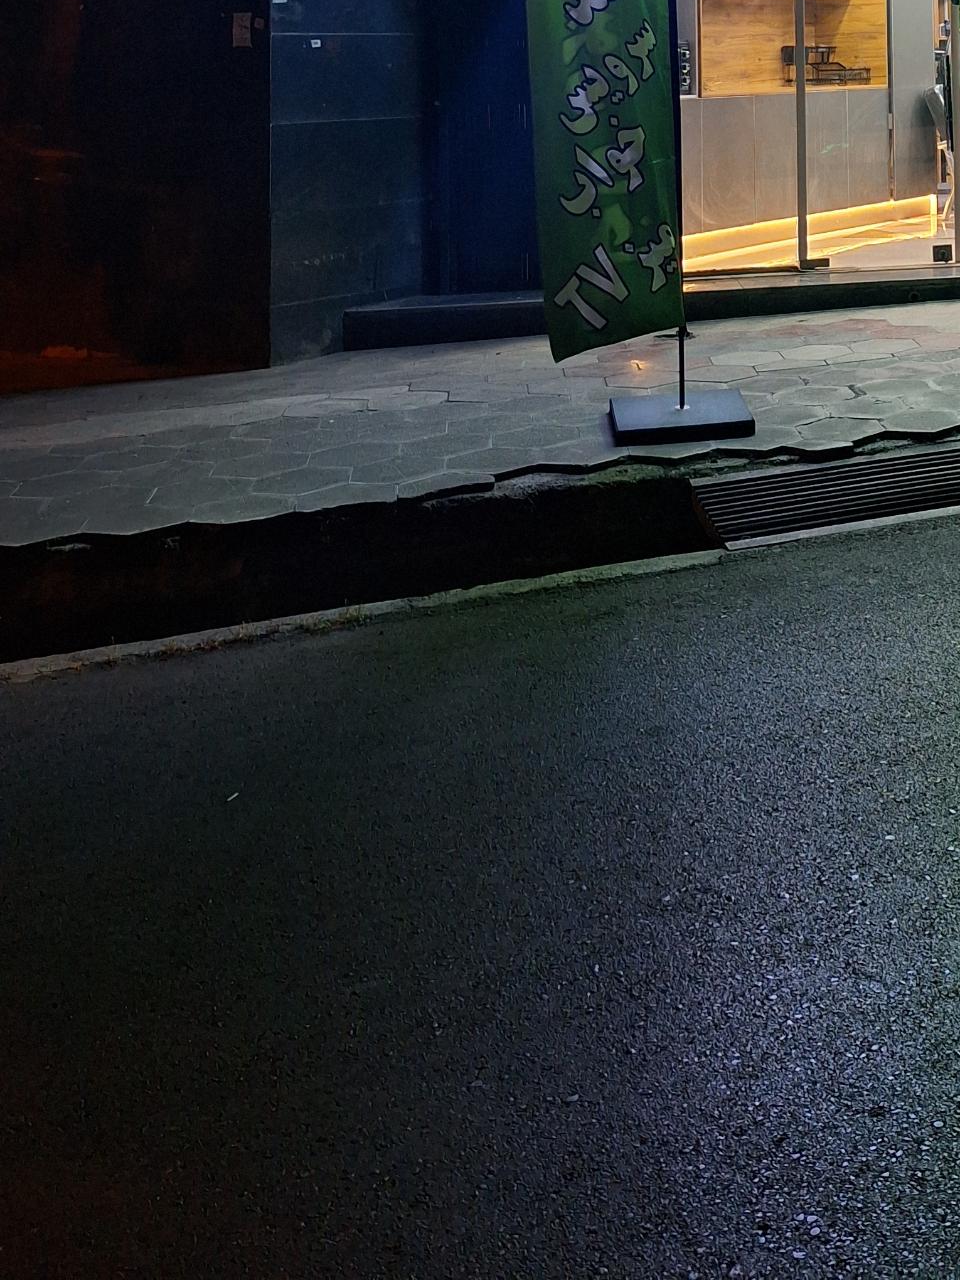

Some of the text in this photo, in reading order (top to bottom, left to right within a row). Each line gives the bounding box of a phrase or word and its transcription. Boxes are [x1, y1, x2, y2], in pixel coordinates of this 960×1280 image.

[558, 18, 658, 136] سرویس
[558, 115, 647, 219] خواب
[553, 222, 678, 331] میز TV
